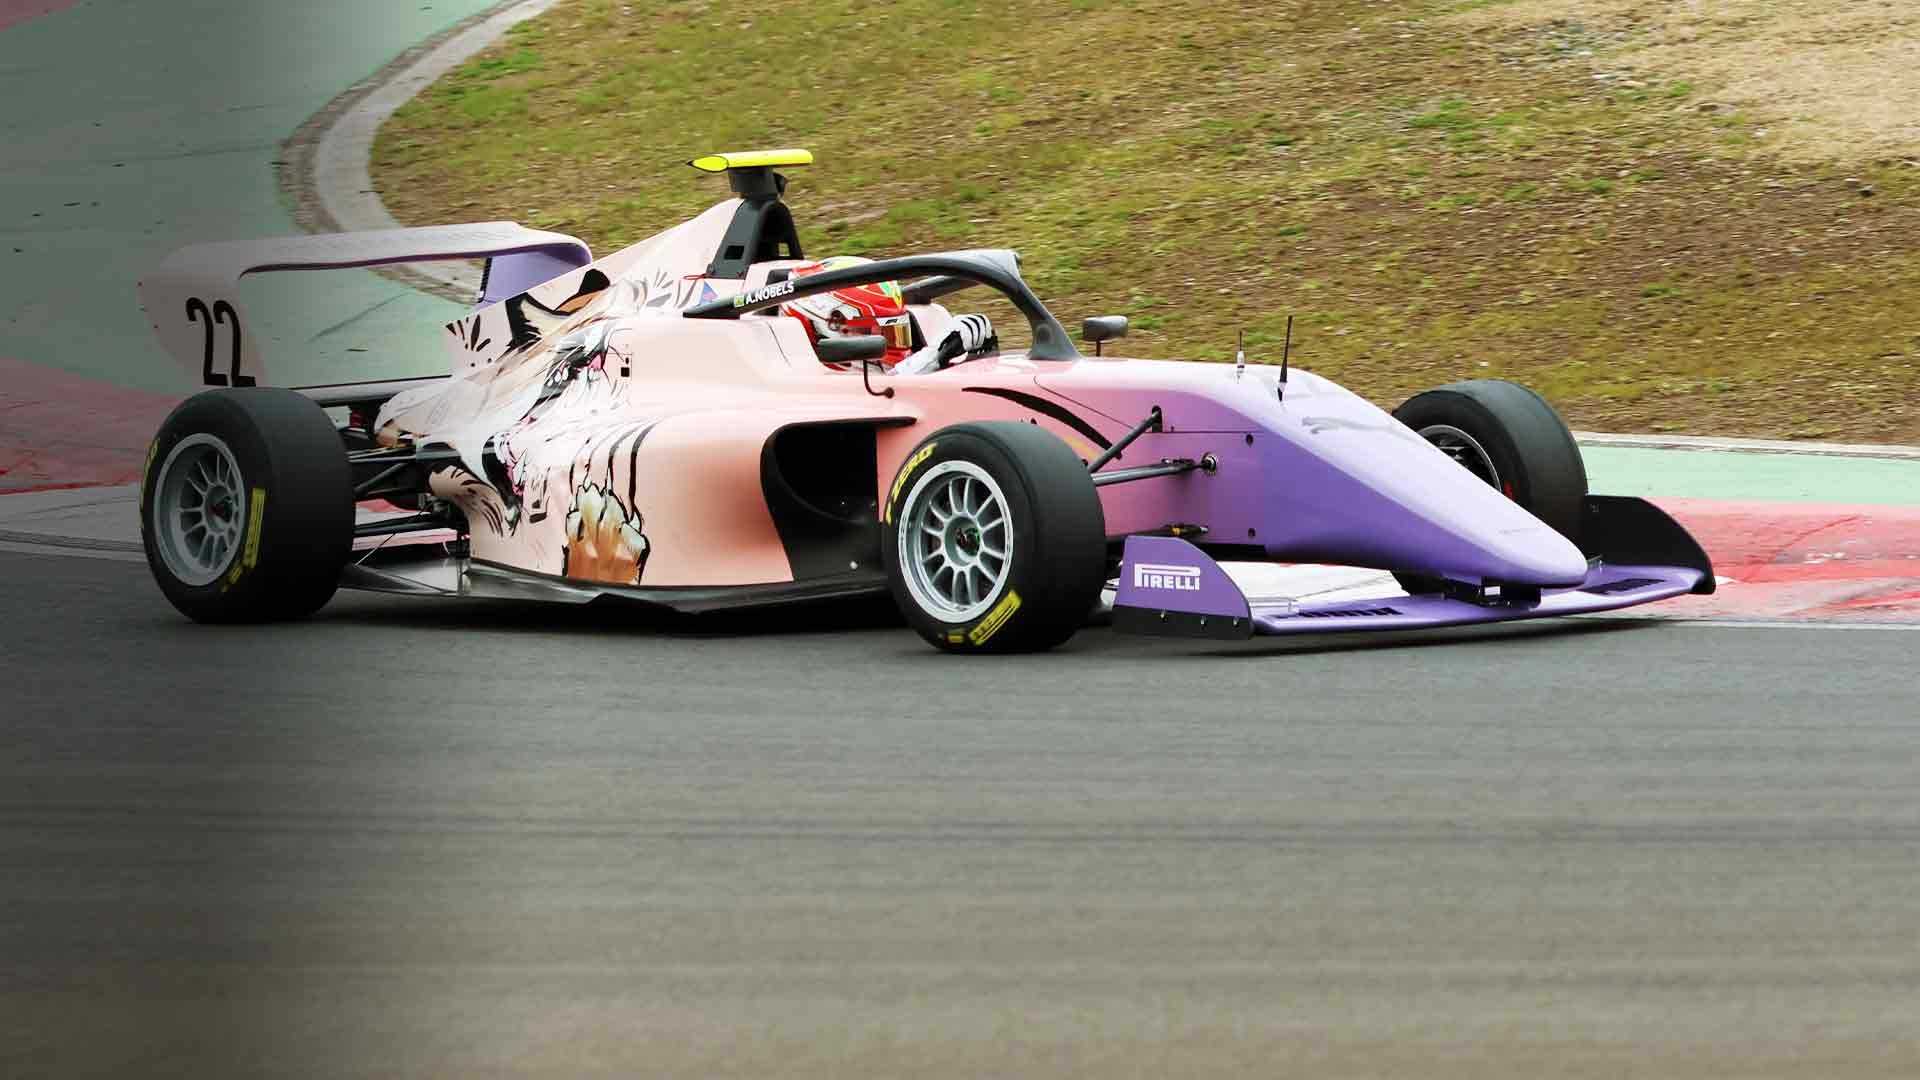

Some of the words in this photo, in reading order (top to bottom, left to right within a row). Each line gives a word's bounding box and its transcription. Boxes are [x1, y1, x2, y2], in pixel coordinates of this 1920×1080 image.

[745, 280, 795, 305] A.NOBELS
[185, 296, 256, 388] 22
[1134, 562, 1201, 592] PIRELLI
